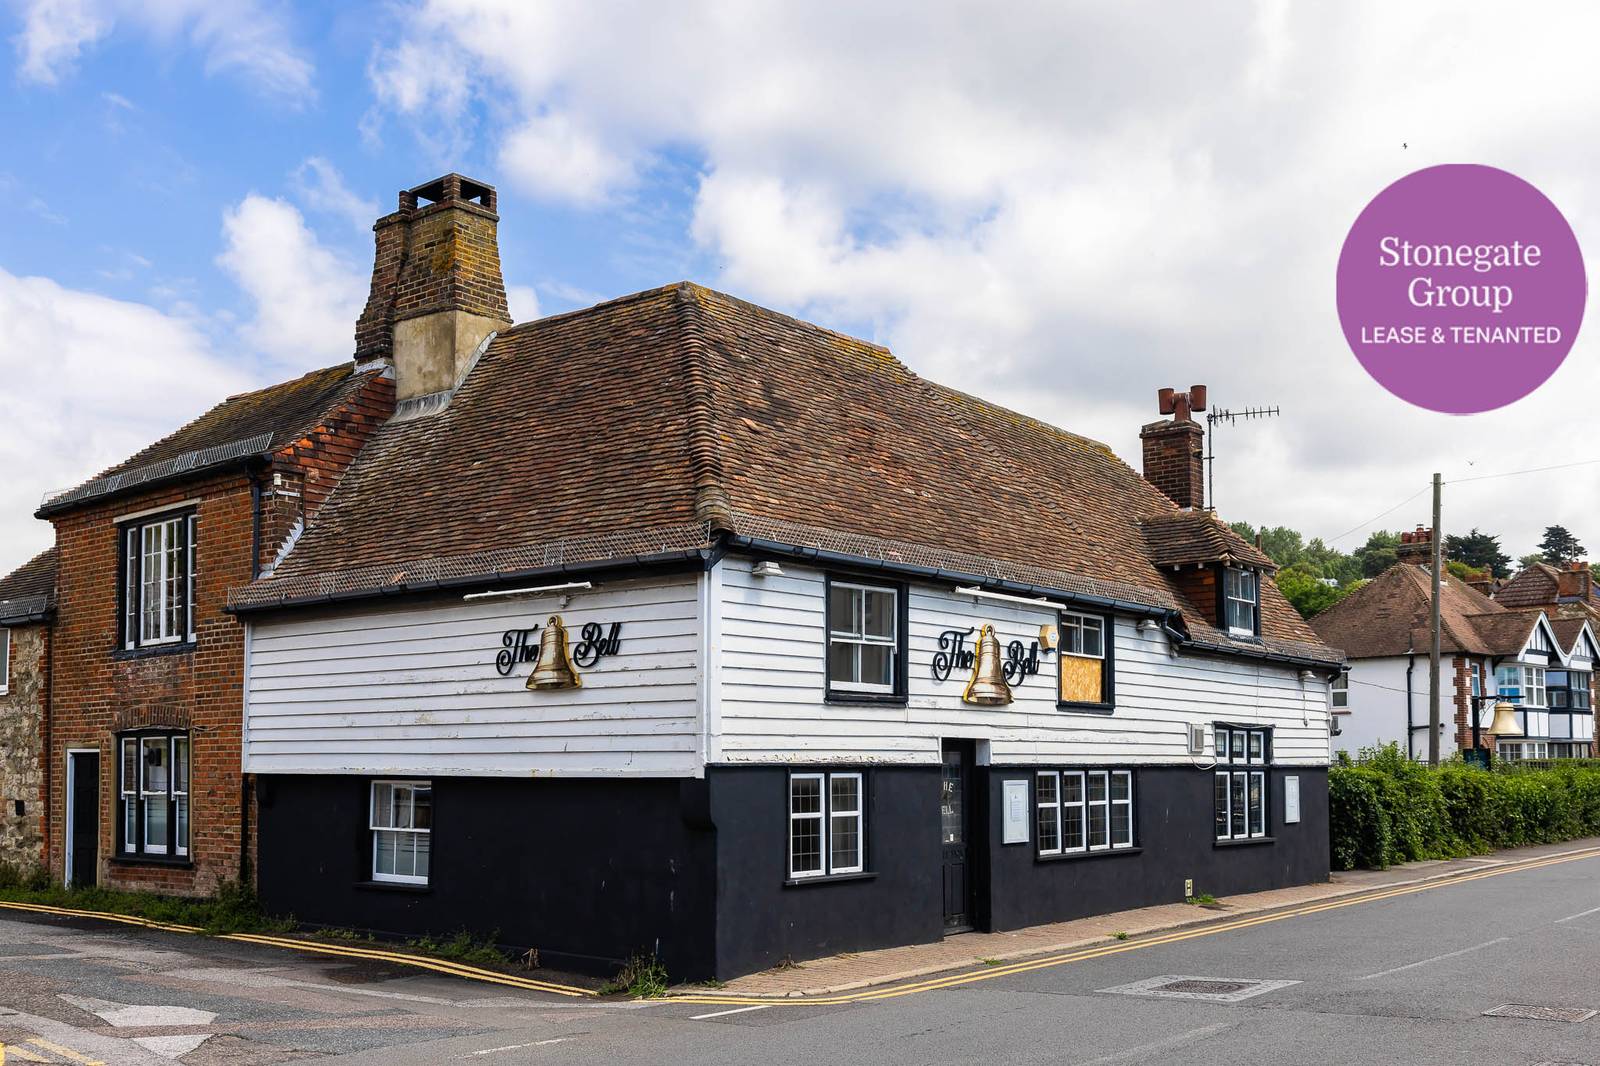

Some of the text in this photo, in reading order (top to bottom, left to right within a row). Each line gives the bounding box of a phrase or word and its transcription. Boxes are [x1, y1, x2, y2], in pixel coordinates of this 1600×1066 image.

[496, 622, 622, 676] The Bell
[932, 626, 1040, 687] The Bell
[943, 781, 954, 792] HE
[941, 805, 954, 815] ELL
